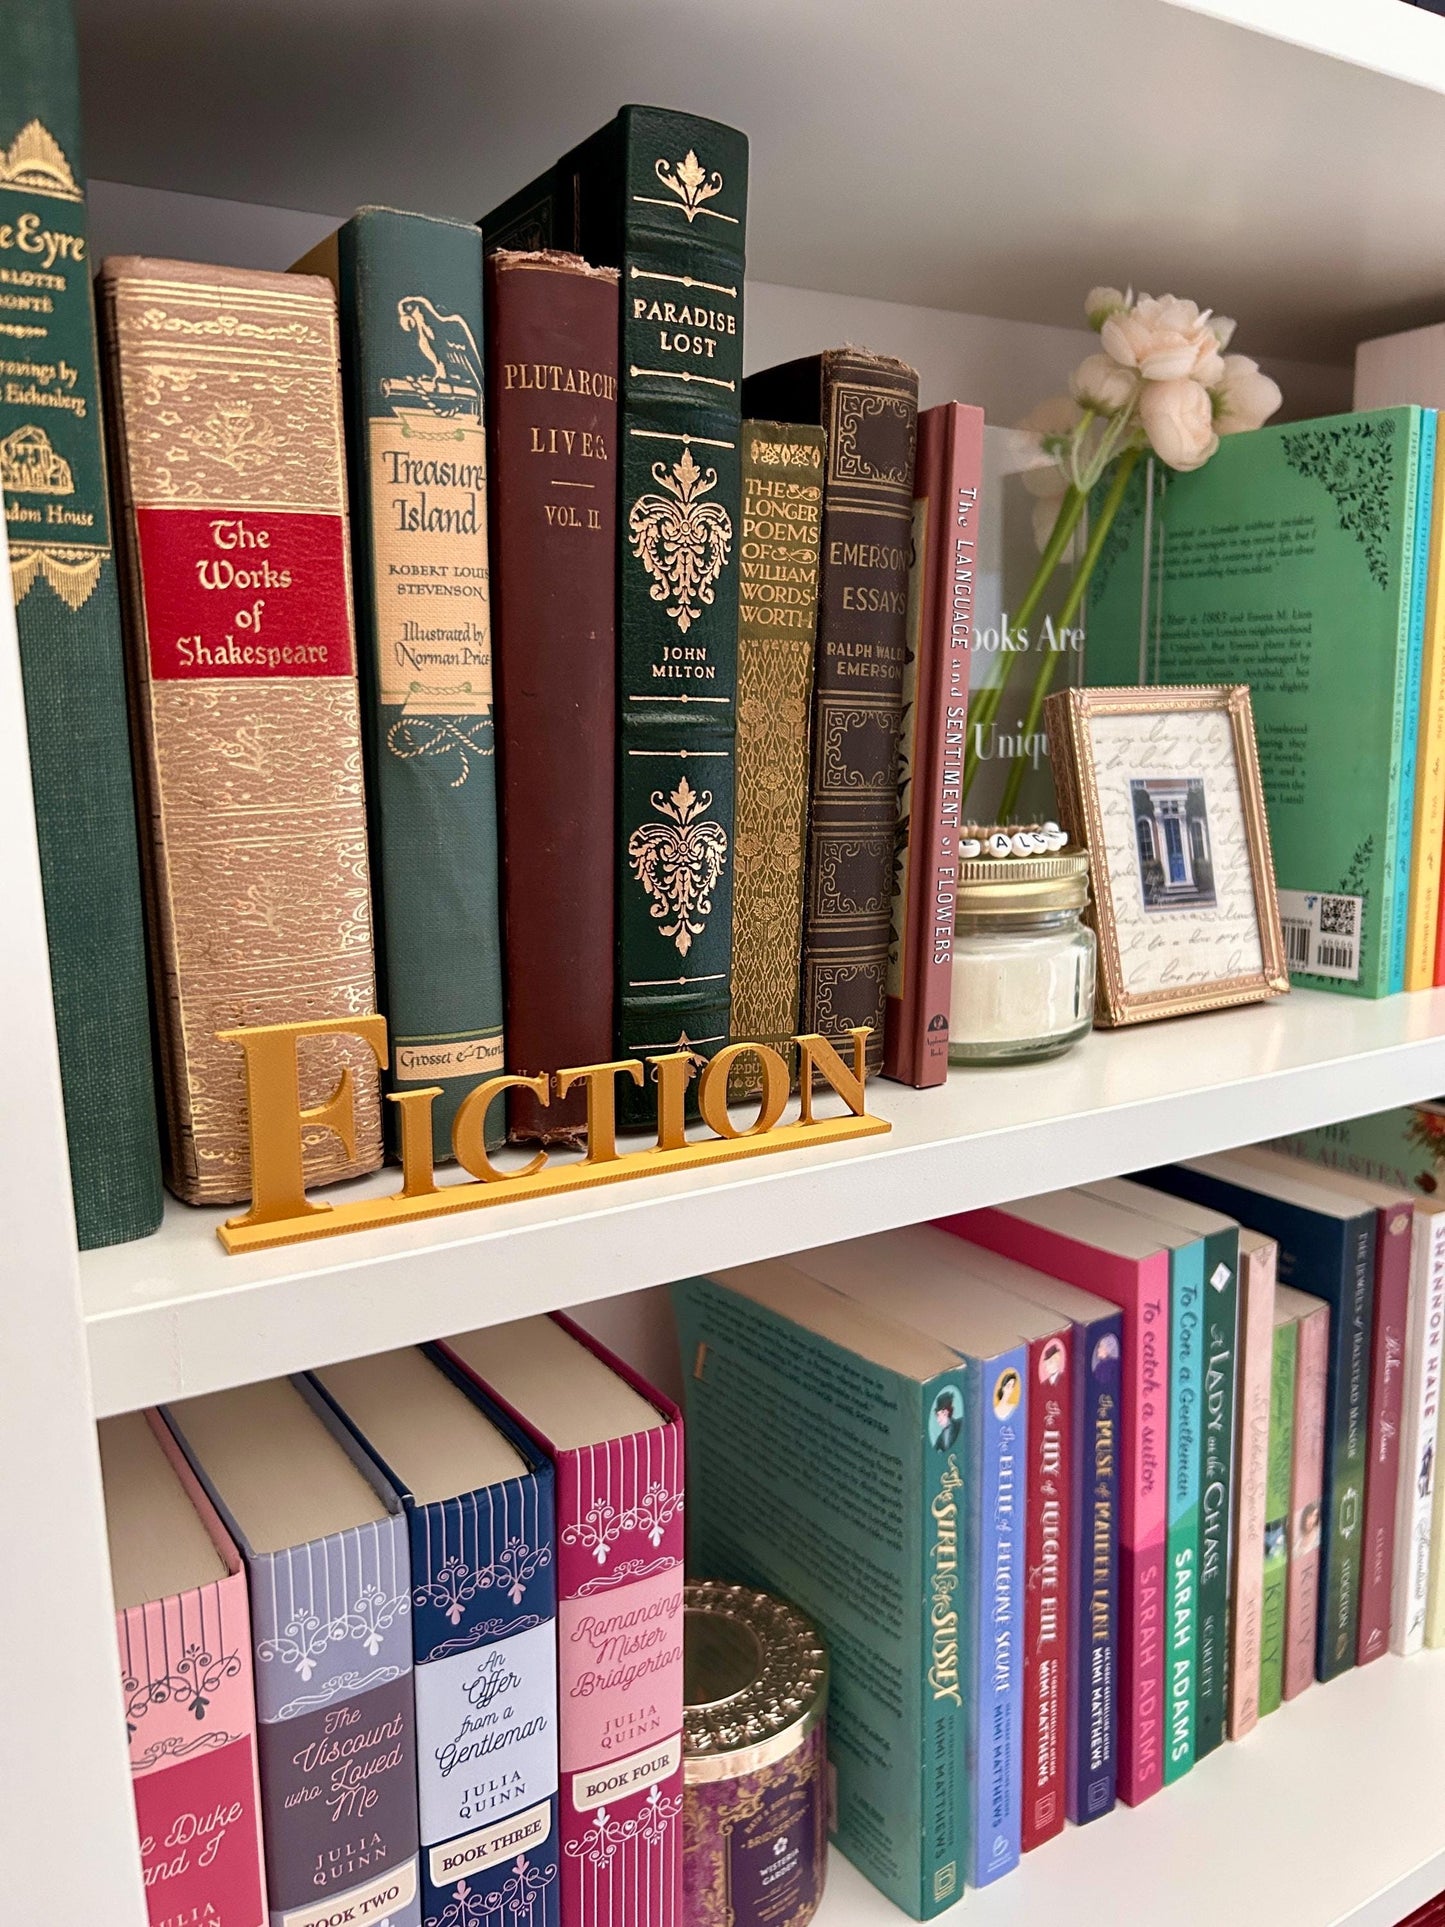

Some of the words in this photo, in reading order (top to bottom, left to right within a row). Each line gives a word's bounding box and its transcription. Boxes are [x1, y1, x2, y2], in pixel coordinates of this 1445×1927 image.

[16, 213, 86, 269] Eyre
[633, 298, 736, 335] PARADISE
[660, 331, 717, 358] LOST
[58, 359, 78, 388] by
[382, 450, 488, 491] Treasure
[745, 478, 786, 498] THE
[47, 504, 94, 526] House
[393, 491, 483, 535] Island
[544, 505, 582, 528] VOL.
[744, 497, 819, 522] LONGER
[956, 487, 977, 528] The
[209, 519, 271, 550] The
[743, 518, 818, 544] POEMS
[741, 542, 773, 559] OF
[195, 559, 293, 590] Works
[388, 564, 449, 577] ROBERT
[454, 566, 489, 580] LOUIS
[740, 562, 816, 584] WILLIAM
[397, 584, 487, 601] STEVENSON
[842, 587, 905, 615] ESSAYS
[951, 538, 974, 650] LANGUAGE
[235, 600, 265, 633] of
[400, 620, 471, 643] Illustrated
[472, 623, 487, 646] by
[739, 604, 813, 629] WORTH
[1037, 614, 1086, 651] Are
[176, 634, 329, 668] Shakespeare
[393, 642, 460, 671] Norman
[663, 646, 706, 661] JOHN
[826, 641, 872, 658] RALPH
[652, 664, 715, 679] MILTON
[837, 661, 901, 680] EMERSON
[950, 658, 963, 698] and
[941, 706, 964, 828] SENTIMENT
[942, 837, 954, 857] of
[934, 866, 956, 965] FLOWERS
[400, 1051, 452, 1069] Grosset
[456, 1044, 477, 1063] &
[215, 1014, 875, 1230] FICTION
[1357, 1232, 1369, 1262] THE
[1180, 1284, 1198, 1308] To
[1427, 1226, 1445, 1348] SHANNON
[1142, 1299, 1161, 1325] To
[1179, 1311, 1198, 1361] Con
[1179, 1366, 1191, 1385] a
[1205, 1350, 1230, 1432] LADY
[1423, 1356, 1438, 1419] HALE
[1142, 1402, 1154, 1421] a
[1095, 1419, 1113, 1479] MUSE
[1177, 1388, 1196, 1501] Gentleman
[930, 1493, 958, 1588] SIREN
[1093, 1501, 1111, 1585] MAIDEN
[1201, 1481, 1225, 1585] CHASE
[1173, 1548, 1192, 1649] SARAH
[1337, 1558, 1351, 1629] STOCKTON
[570, 1592, 682, 1645] Romancing
[1089, 1589, 1109, 1643] LANE
[1139, 1565, 1156, 1667] SARAH
[1262, 1582, 1281, 1665] KELLY
[478, 1650, 505, 1674] An
[595, 1627, 667, 1664] Mister
[927, 1602, 963, 1708] SUSSEX
[570, 1645, 682, 1698] Bridgerton
[1038, 1659, 1050, 1698] MIMI
[1092, 1646, 1103, 1684] MIMI
[462, 1668, 522, 1709] Offer
[324, 1706, 362, 1735] The
[454, 1712, 499, 1742] from
[503, 1705, 514, 1720] a
[603, 1704, 657, 1735] JULIA
[994, 1703, 1002, 1744] MIMI
[1090, 1688, 1103, 1771] MATTHEWS
[1171, 1659, 1192, 1762] ADAMS
[293, 1712, 404, 1772] Viscount
[434, 1715, 547, 1778] Gentleman
[600, 1716, 661, 1750] QUINN
[934, 1716, 946, 1759] MIMI
[1037, 1702, 1050, 1787] MATTHEWS
[1138, 1678, 1156, 1782] ADAMS
[284, 1784, 322, 1808] who
[331, 1742, 403, 1792] Loved
[461, 1770, 522, 1805] JULIA
[585, 1773, 629, 1798] BOOK
[632, 1754, 670, 1779] FOUR
[992, 1745, 1002, 1829] MATTHEWS
[325, 1784, 379, 1822] Me
[459, 1782, 527, 1820] QUINN
[934, 1763, 946, 1860] MATTHEWS
[164, 1801, 243, 1847] Duke
[315, 1832, 382, 1871] JULIA
[442, 1844, 488, 1872] BOOK
[491, 1819, 542, 1852] THREE
[759, 1848, 800, 1877] WISTERIA
[143, 1849, 190, 1887] and
[313, 1845, 388, 1886] QUINN
[359, 1886, 400, 1915] TWO
